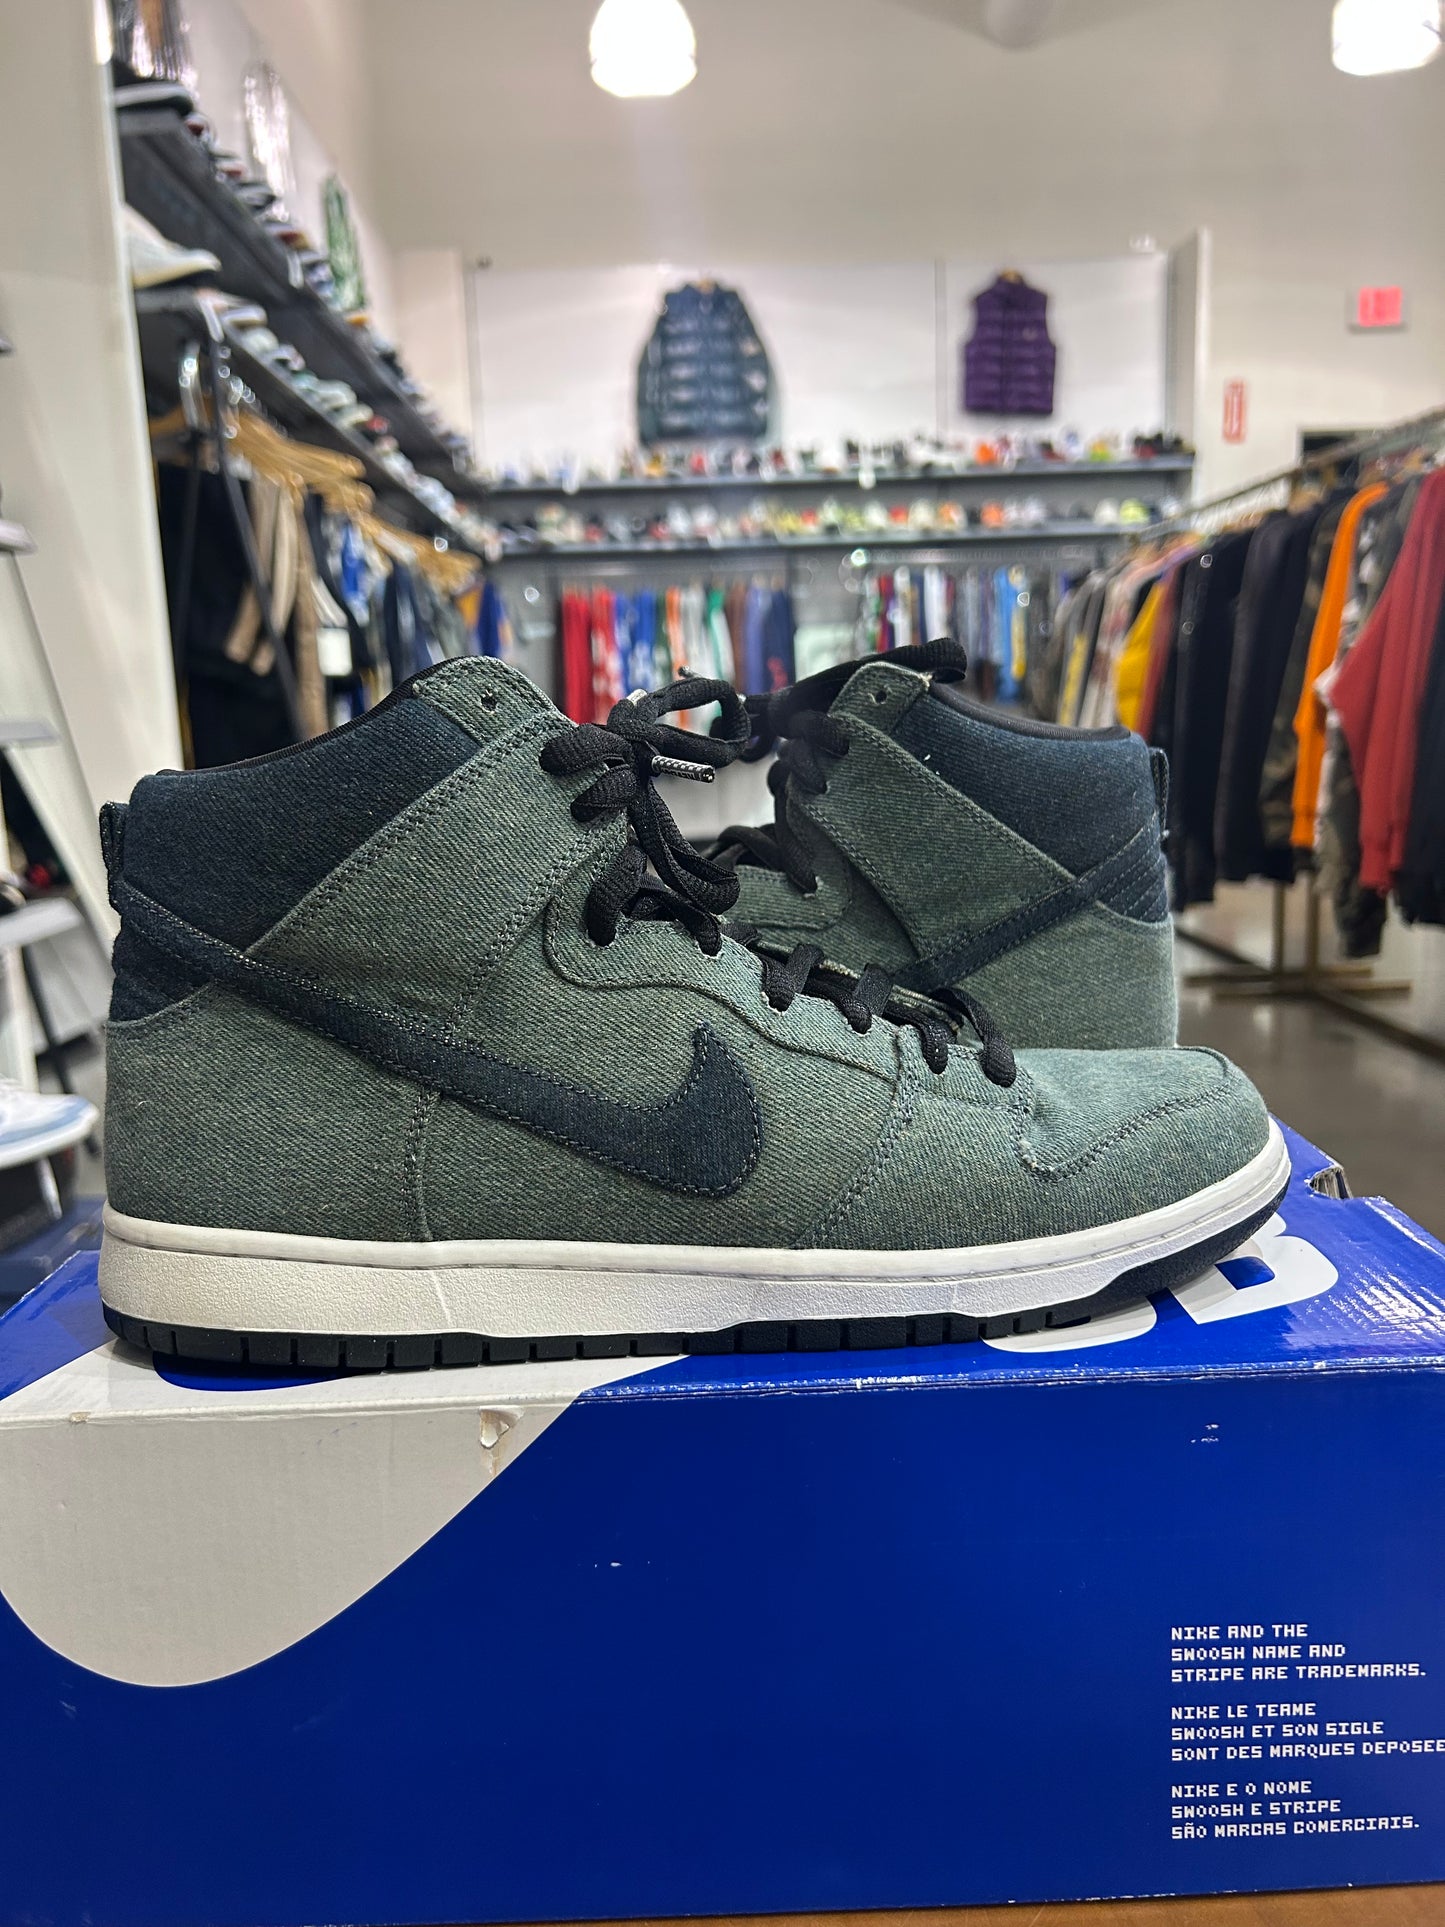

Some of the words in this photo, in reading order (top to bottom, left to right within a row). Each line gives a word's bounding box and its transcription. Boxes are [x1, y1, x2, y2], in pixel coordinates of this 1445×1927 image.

[1171, 1625, 1220, 1641] NIKE
[1227, 1624, 1264, 1639] AND
[1271, 1623, 1308, 1638] THE
[1171, 1646, 1245, 1662] SWOOSH
[1252, 1645, 1302, 1660] NAME
[1308, 1644, 1346, 1658] AND
[1171, 1667, 1245, 1683] STRIPE
[1251, 1666, 1289, 1680] ARE
[1295, 1663, 1427, 1679] TRADEMARKS.
[1171, 1705, 1220, 1720] NIKE
[1227, 1704, 1248, 1719] LE
[1171, 1725, 1245, 1741] SWOOSH
[1251, 1724, 1276, 1738] ET
[1282, 1723, 1319, 1737] SON
[1325, 1721, 1384, 1736] SIGLE
[1171, 1747, 1220, 1762] SONT
[1226, 1745, 1263, 1760] DES
[1269, 1742, 1355, 1759] MARQUES
[1171, 1783, 1220, 1799] NIKE
[1226, 1783, 1238, 1797] E
[1245, 1782, 1257, 1796] O
[1263, 1780, 1312, 1795] NOME
[1171, 1803, 1244, 1819] SWOOSH
[1251, 1802, 1263, 1816] E
[1269, 1799, 1341, 1815] STRIPE
[1171, 1821, 1208, 1840] SÃO
[1214, 1822, 1287, 1838] MARCAS
[1293, 1815, 1420, 1835] COMERCIAIS.
